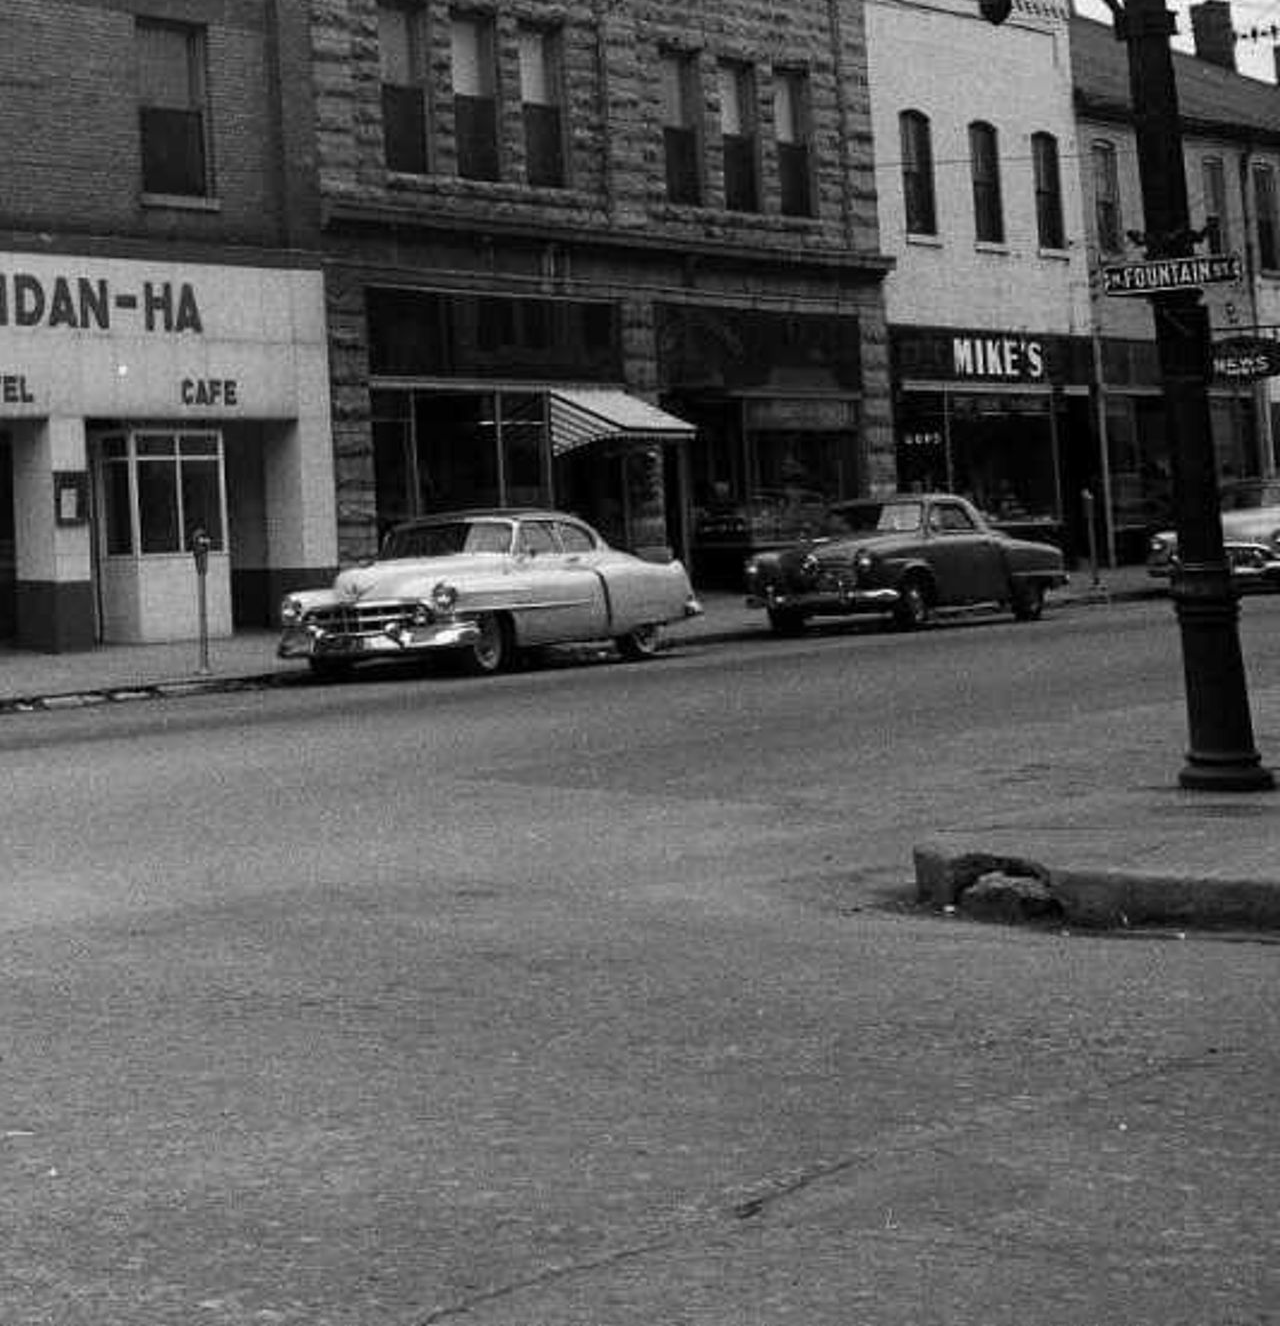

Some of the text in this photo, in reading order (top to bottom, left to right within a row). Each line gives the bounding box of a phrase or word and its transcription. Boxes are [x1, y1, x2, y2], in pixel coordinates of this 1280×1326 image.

[1124, 260, 1210, 289] FOUNTAIN
[953, 338, 1042, 377] MIKE'S
[181, 378, 238, 406] CAFE
